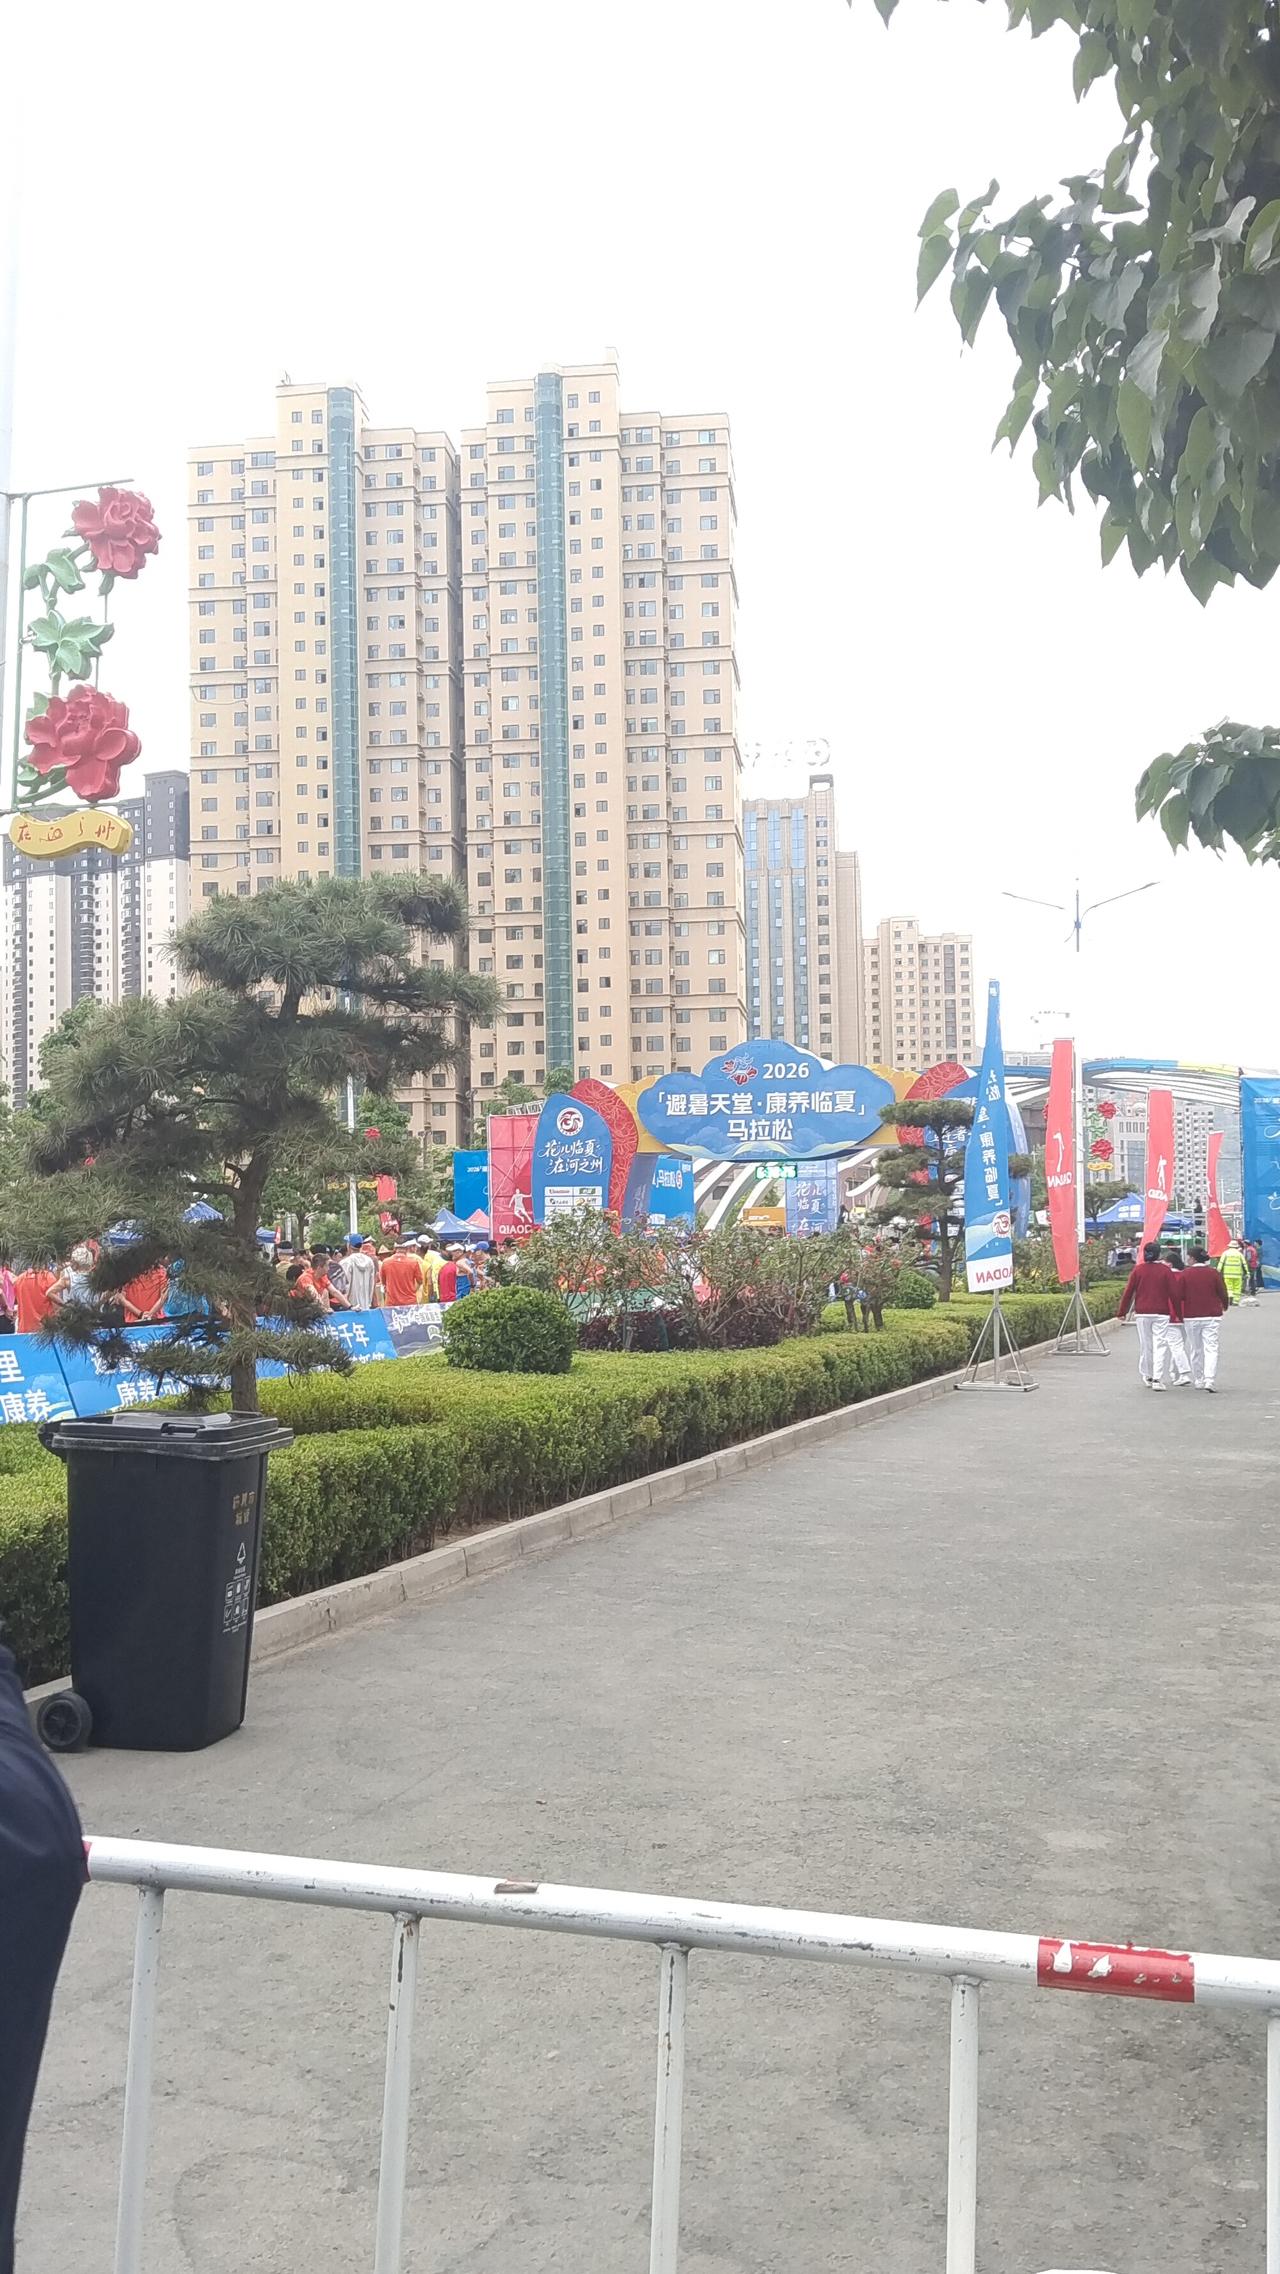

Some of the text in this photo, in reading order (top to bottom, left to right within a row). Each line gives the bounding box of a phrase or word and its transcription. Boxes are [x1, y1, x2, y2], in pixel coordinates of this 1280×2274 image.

[762, 1063, 809, 1079] 2026
[656, 1090, 865, 1116] 「避暑天堂·康养临夏」
[727, 1119, 793, 1141] 马拉松
[538, 1139, 600, 1157] 花儿临夏
